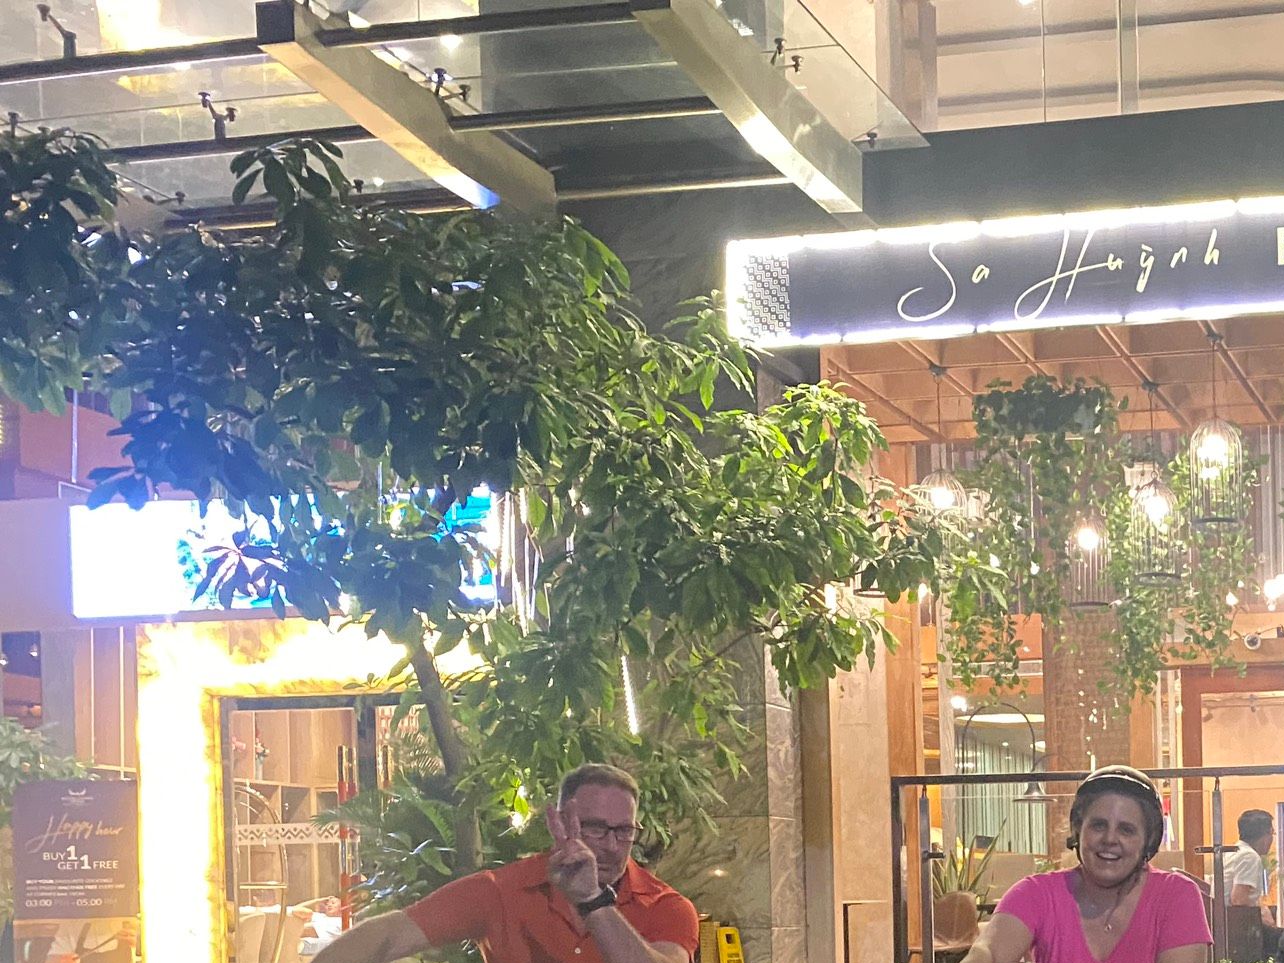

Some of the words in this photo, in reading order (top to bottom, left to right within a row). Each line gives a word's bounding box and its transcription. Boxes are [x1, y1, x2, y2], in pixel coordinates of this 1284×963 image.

[25, 813, 94, 853] Happy
[96, 820, 124, 836] hour
[43, 852, 66, 861] BUY
[66, 845, 78, 861] 1
[57, 861, 80, 870] GET
[80, 854, 92, 870] 1
[93, 860, 120, 869] FREE
